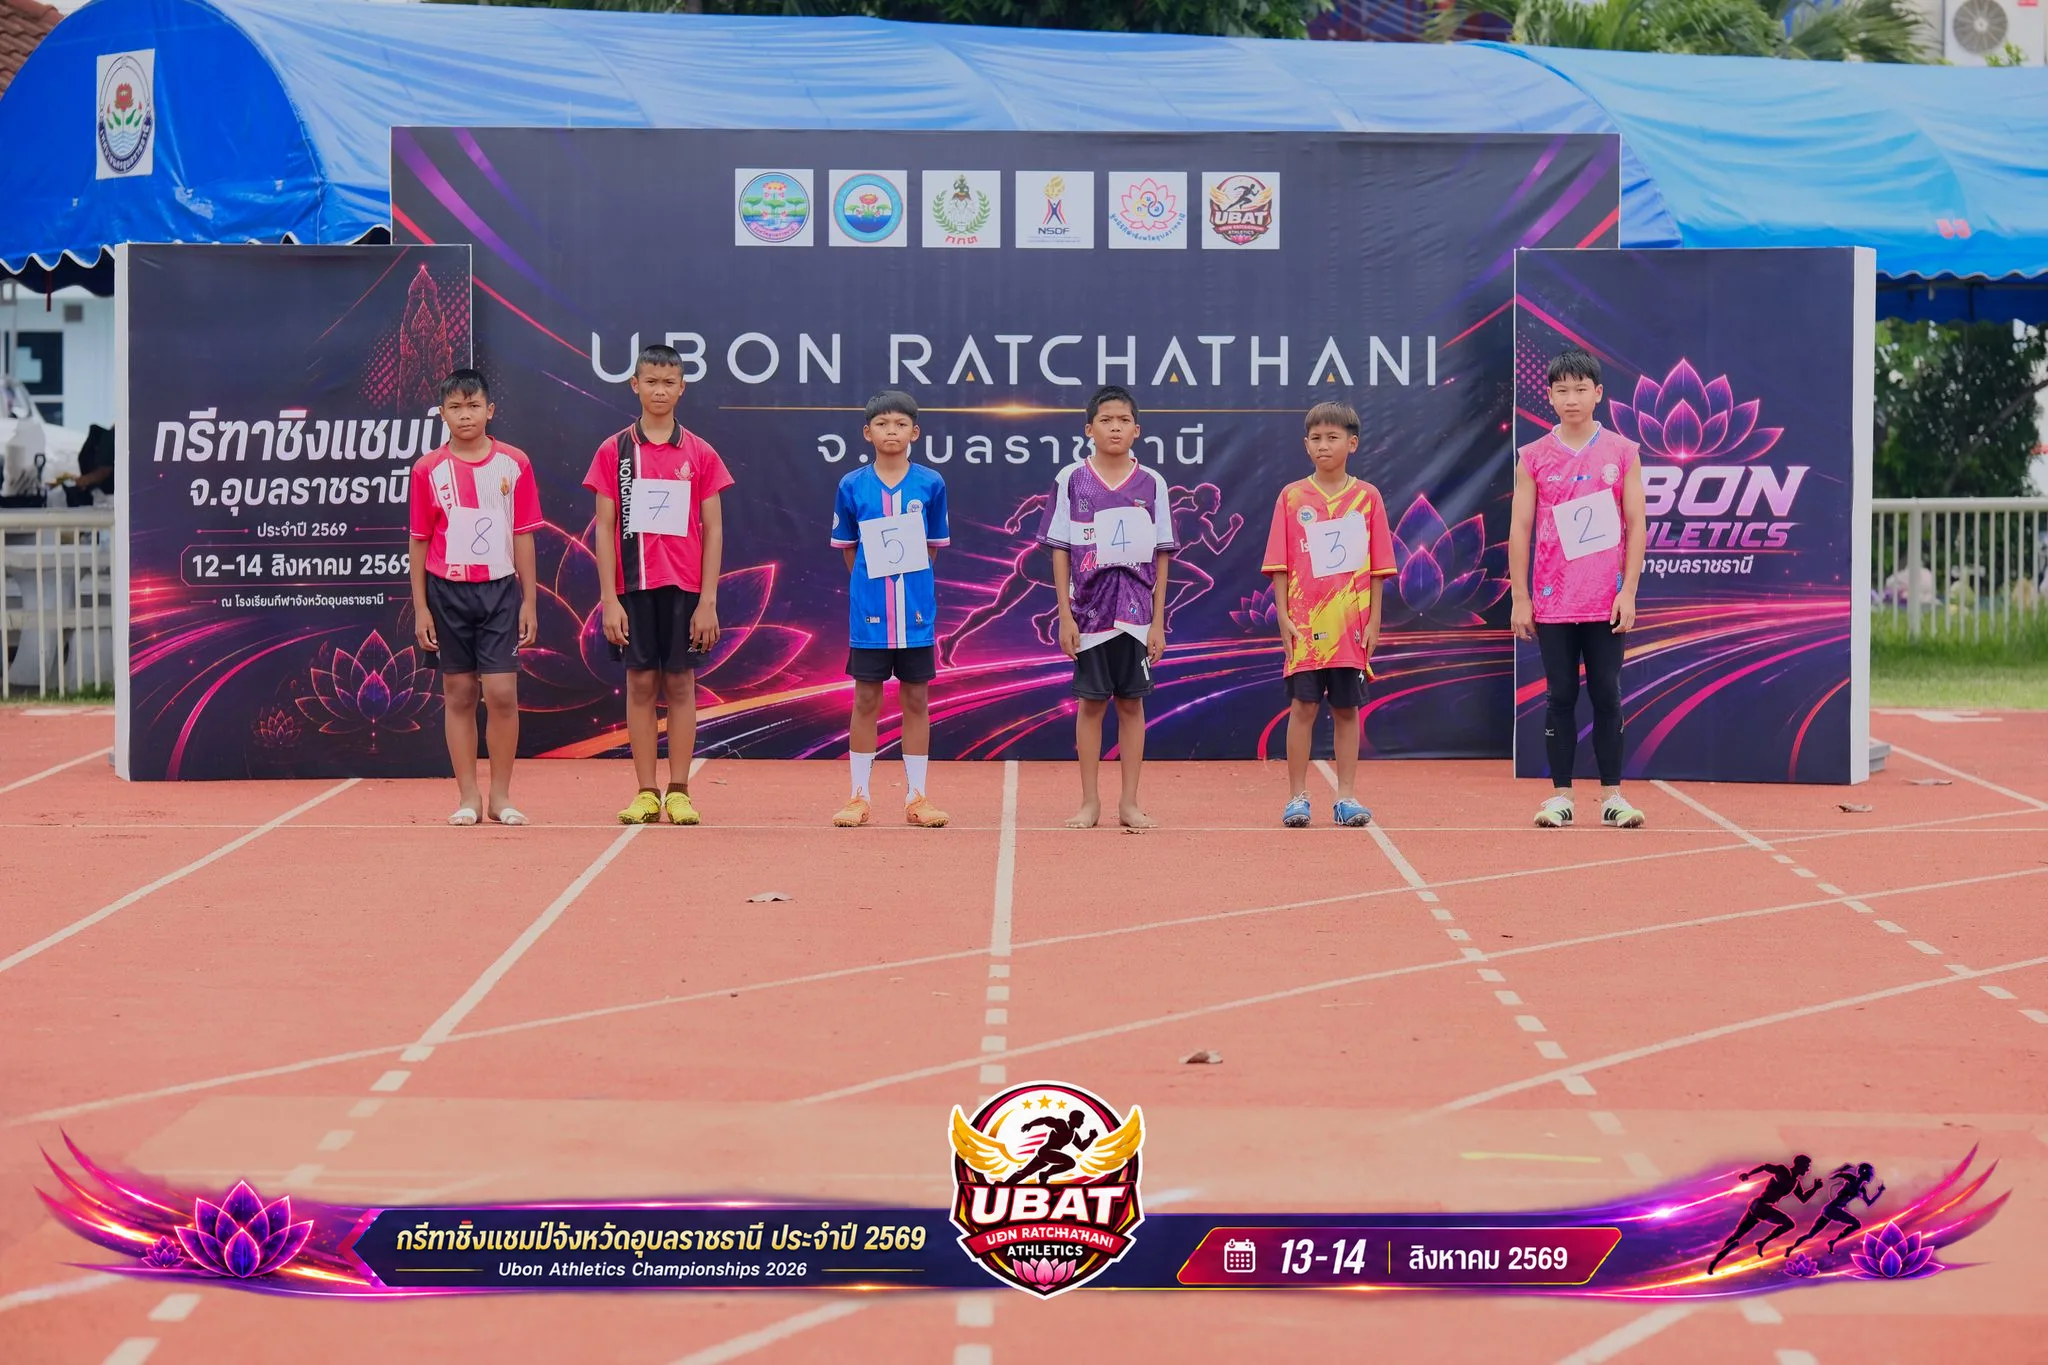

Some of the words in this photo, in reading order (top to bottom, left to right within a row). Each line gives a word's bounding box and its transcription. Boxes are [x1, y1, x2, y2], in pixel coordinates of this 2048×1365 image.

[1038, 227, 1070, 235] NSDF
[1214, 211, 1268, 225] UBAT
[591, 331, 841, 384] UBON
[890, 334, 1437, 386] RATCHATHANI
[190, 466, 411, 517] จ.อุบลราชธานี
[647, 490, 671, 521] 7
[1642, 465, 1811, 516] BON
[257, 521, 307, 538] ประจำปี
[311, 522, 348, 537] 2569
[470, 516, 493, 556] 8
[1111, 519, 1132, 553] 4
[1572, 505, 1606, 544] 2
[880, 527, 905, 565] 5
[1324, 531, 1347, 569] 3
[271, 554, 352, 577] สิงหาคม
[360, 553, 411, 576] 2569
[221, 597, 232, 608] ณ
